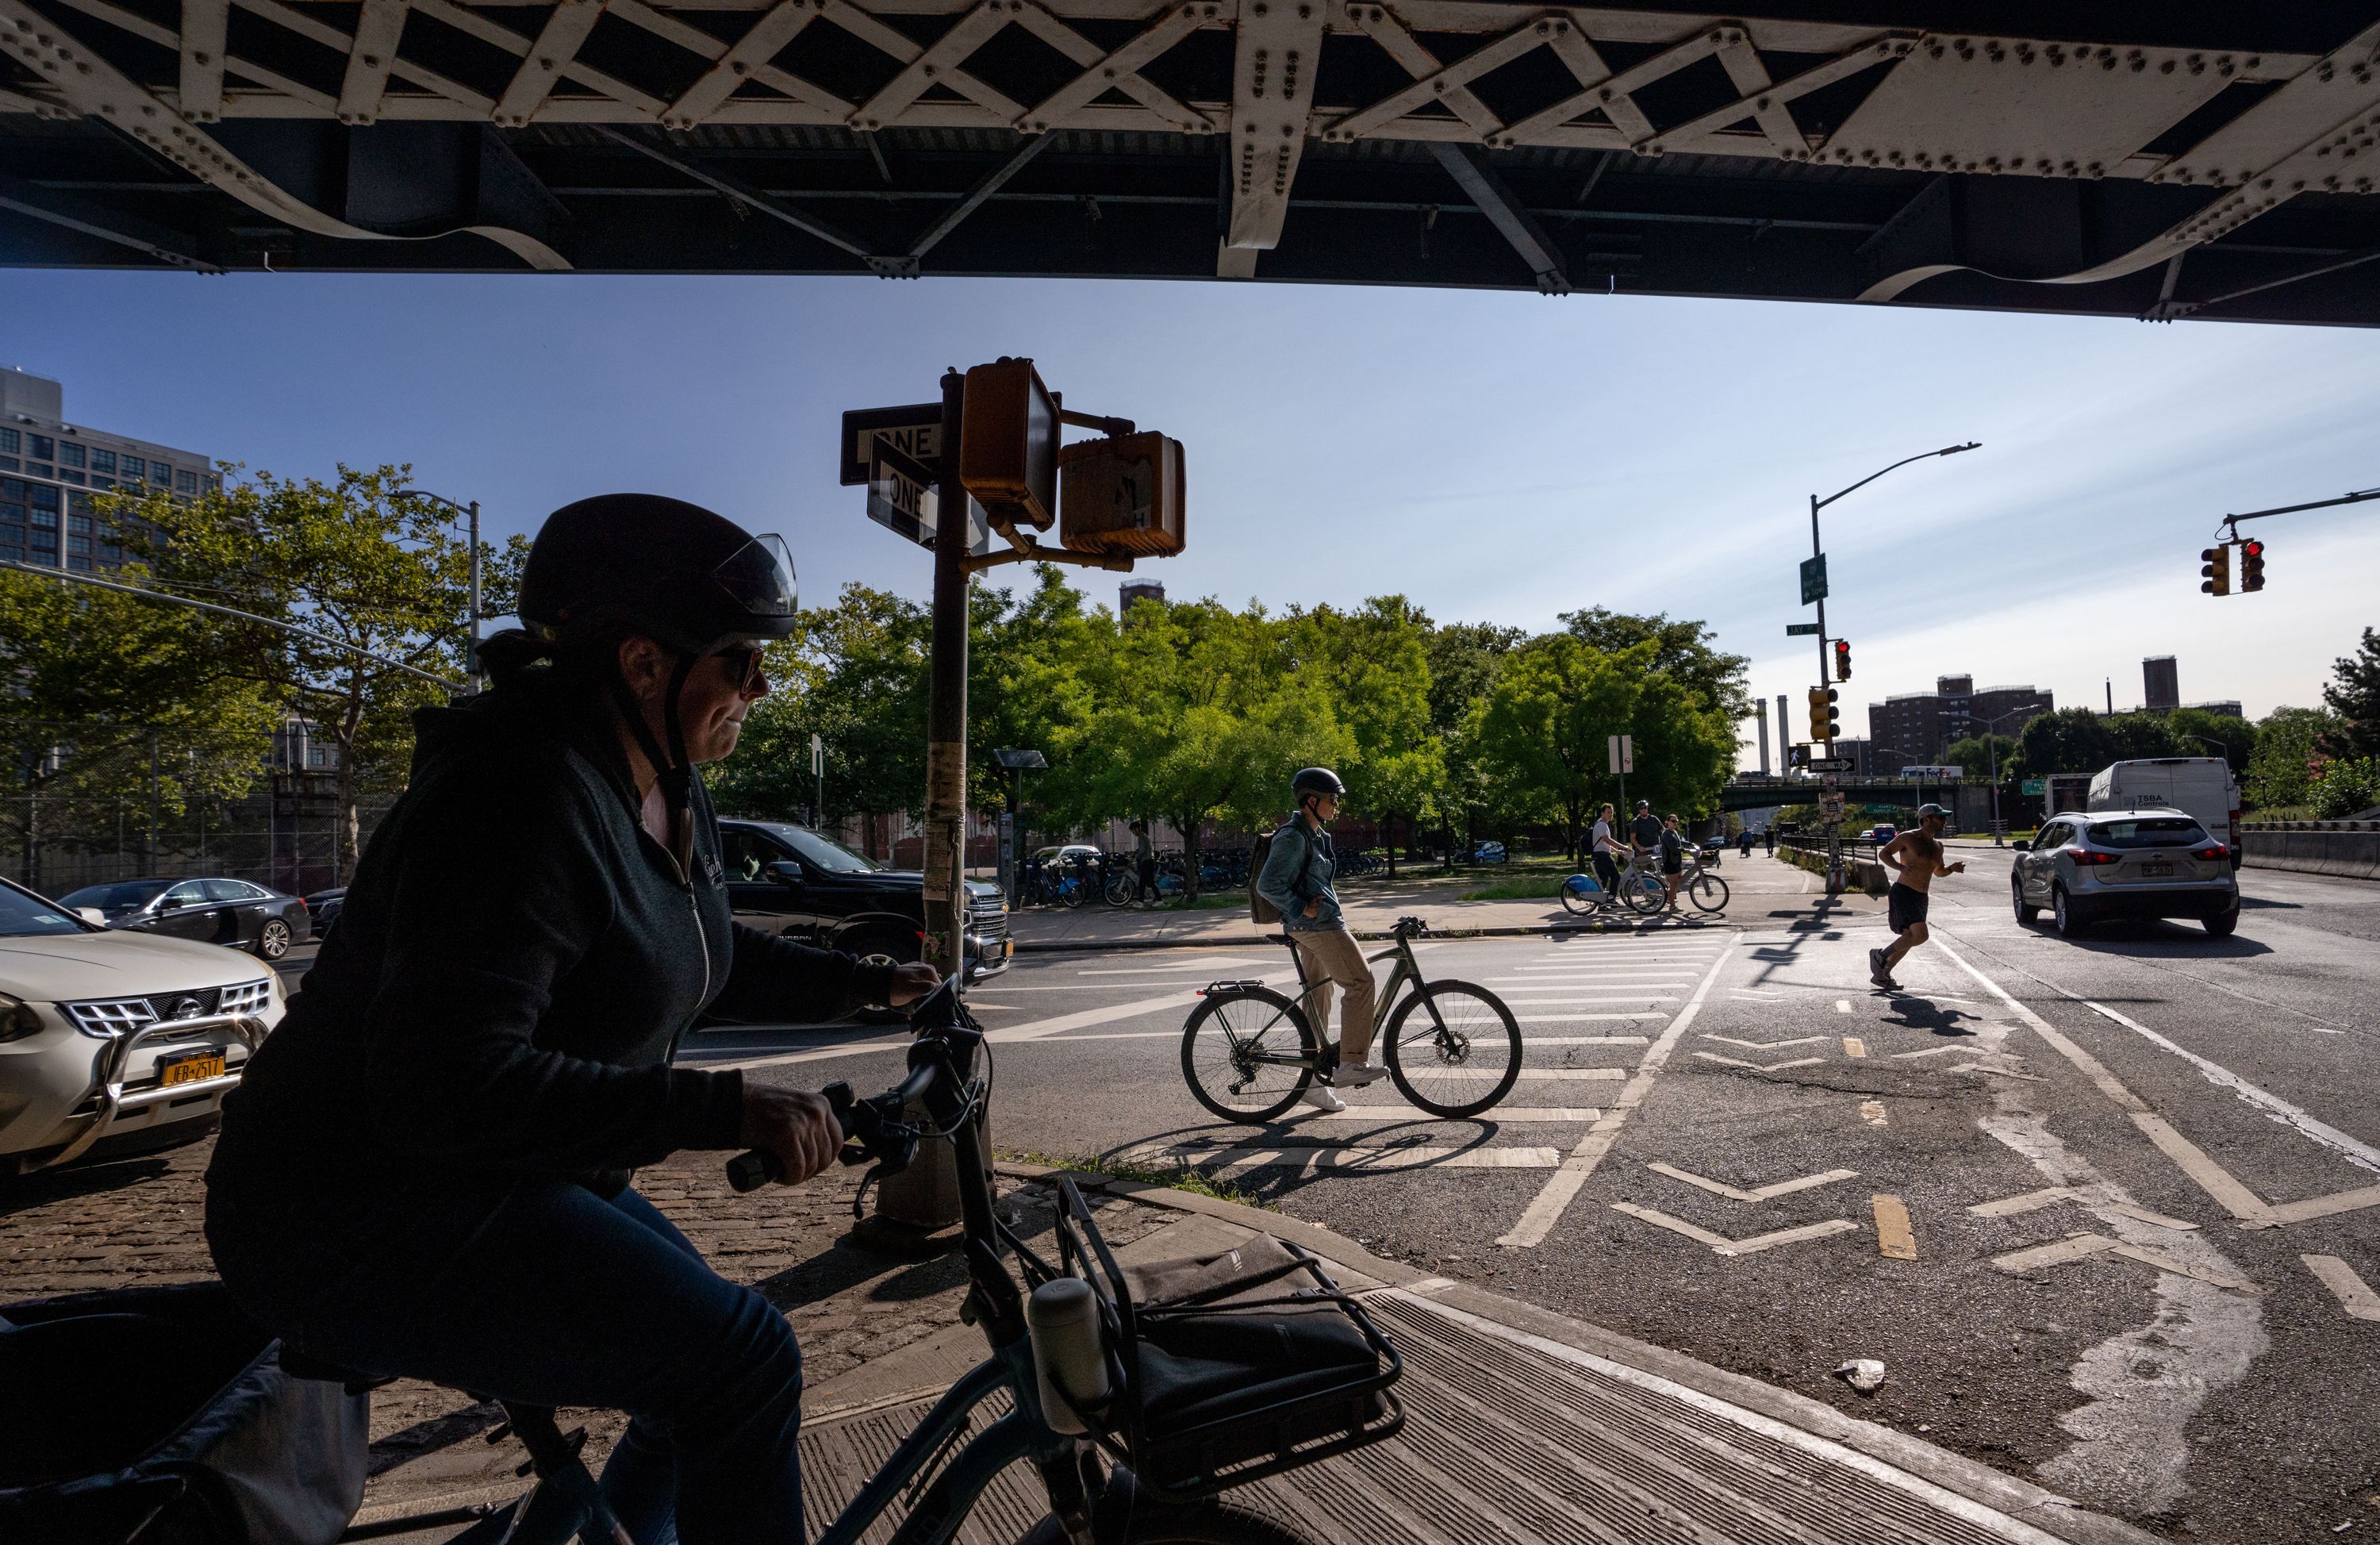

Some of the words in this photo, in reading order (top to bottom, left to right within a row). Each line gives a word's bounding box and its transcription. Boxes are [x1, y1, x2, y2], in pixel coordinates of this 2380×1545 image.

[890, 473, 923, 518] ONE
[1790, 625, 1803, 635] JAY
[1926, 767, 1952, 777] FedEx
